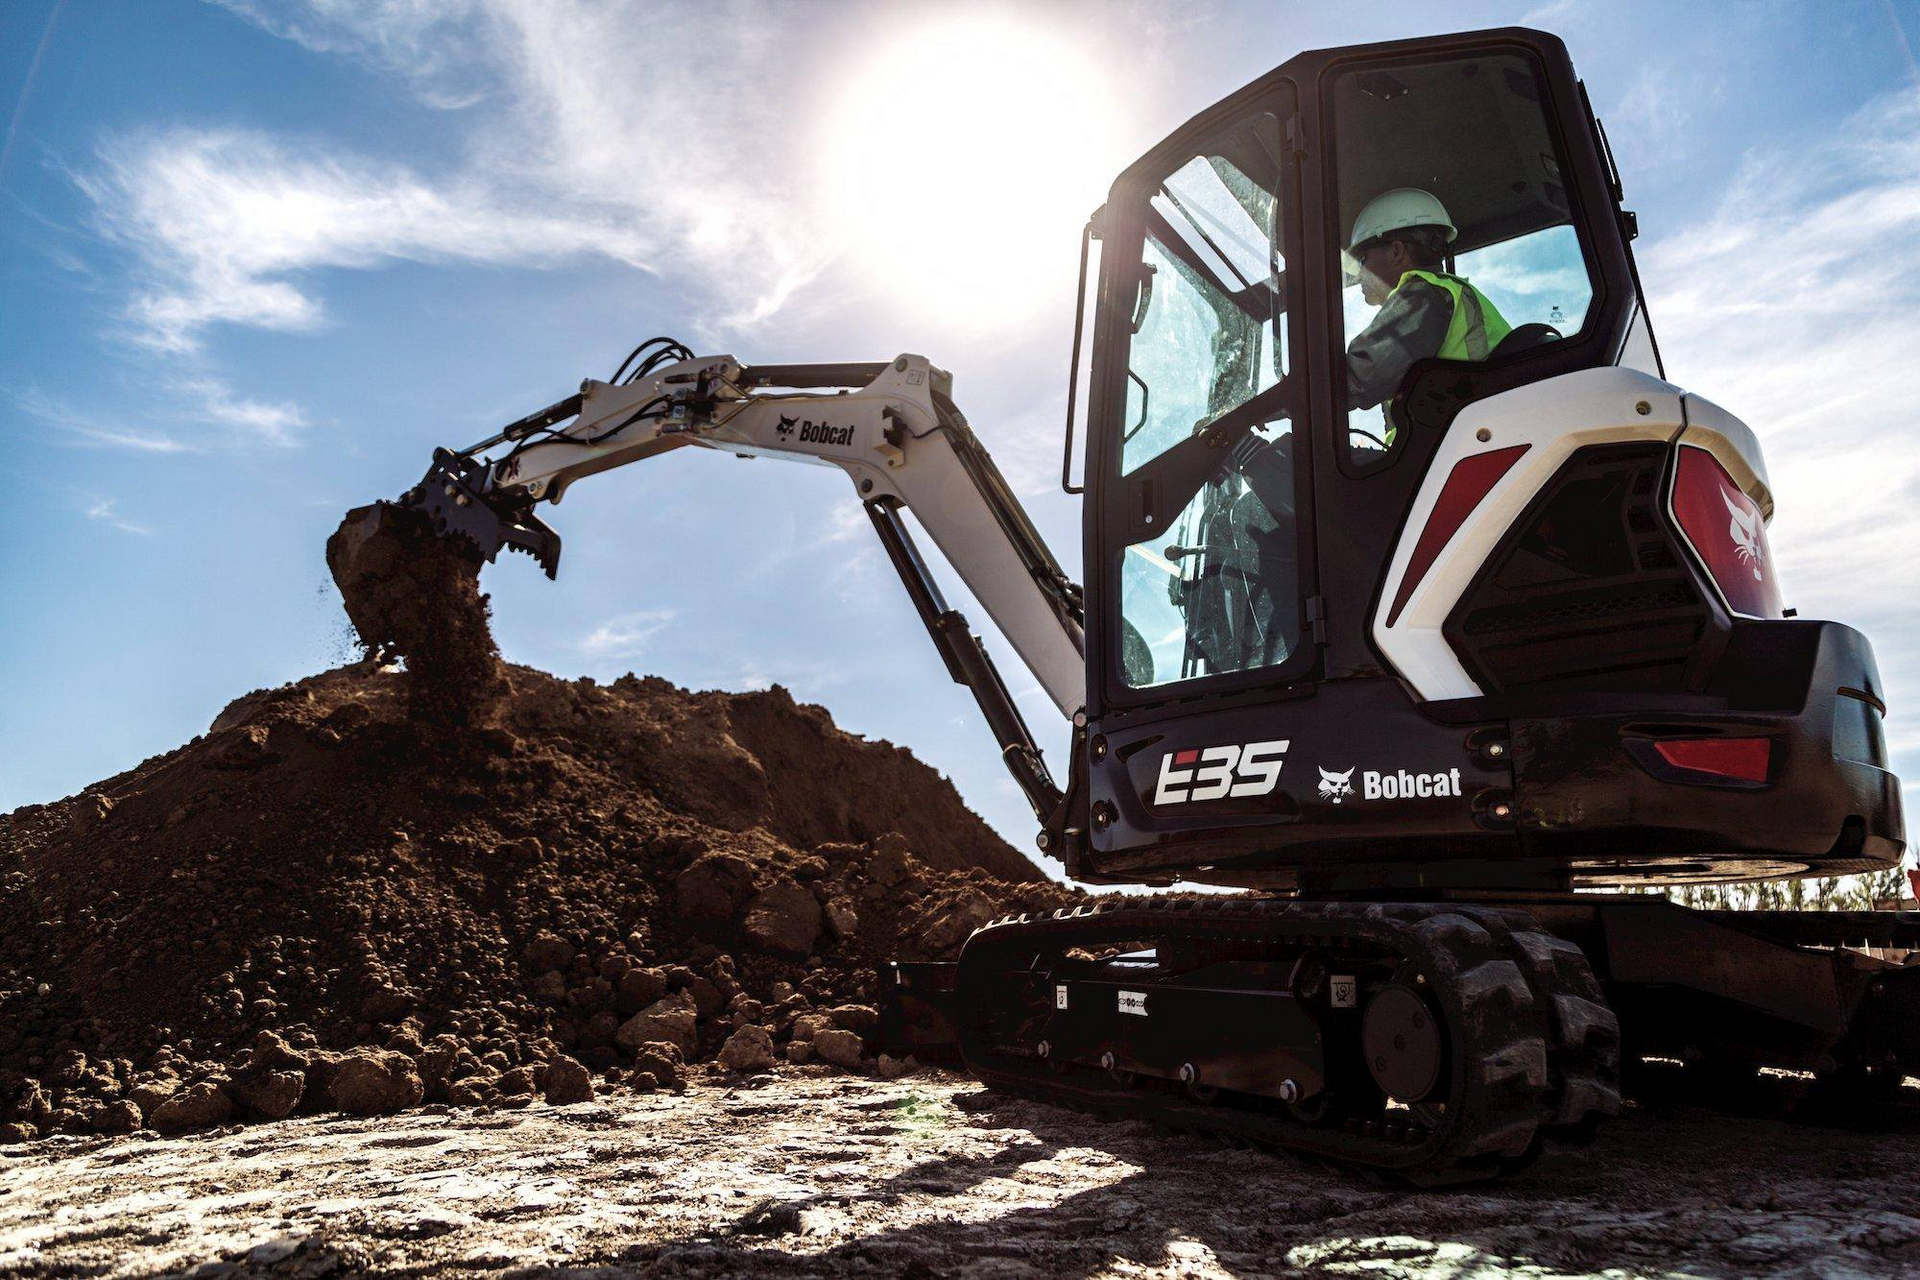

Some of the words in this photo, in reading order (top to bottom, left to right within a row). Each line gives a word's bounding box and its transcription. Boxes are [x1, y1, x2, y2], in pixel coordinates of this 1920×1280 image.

[799, 420, 855, 446] Bobcat
[1154, 740, 1290, 805] E35
[1363, 767, 1462, 799] Bobcat
